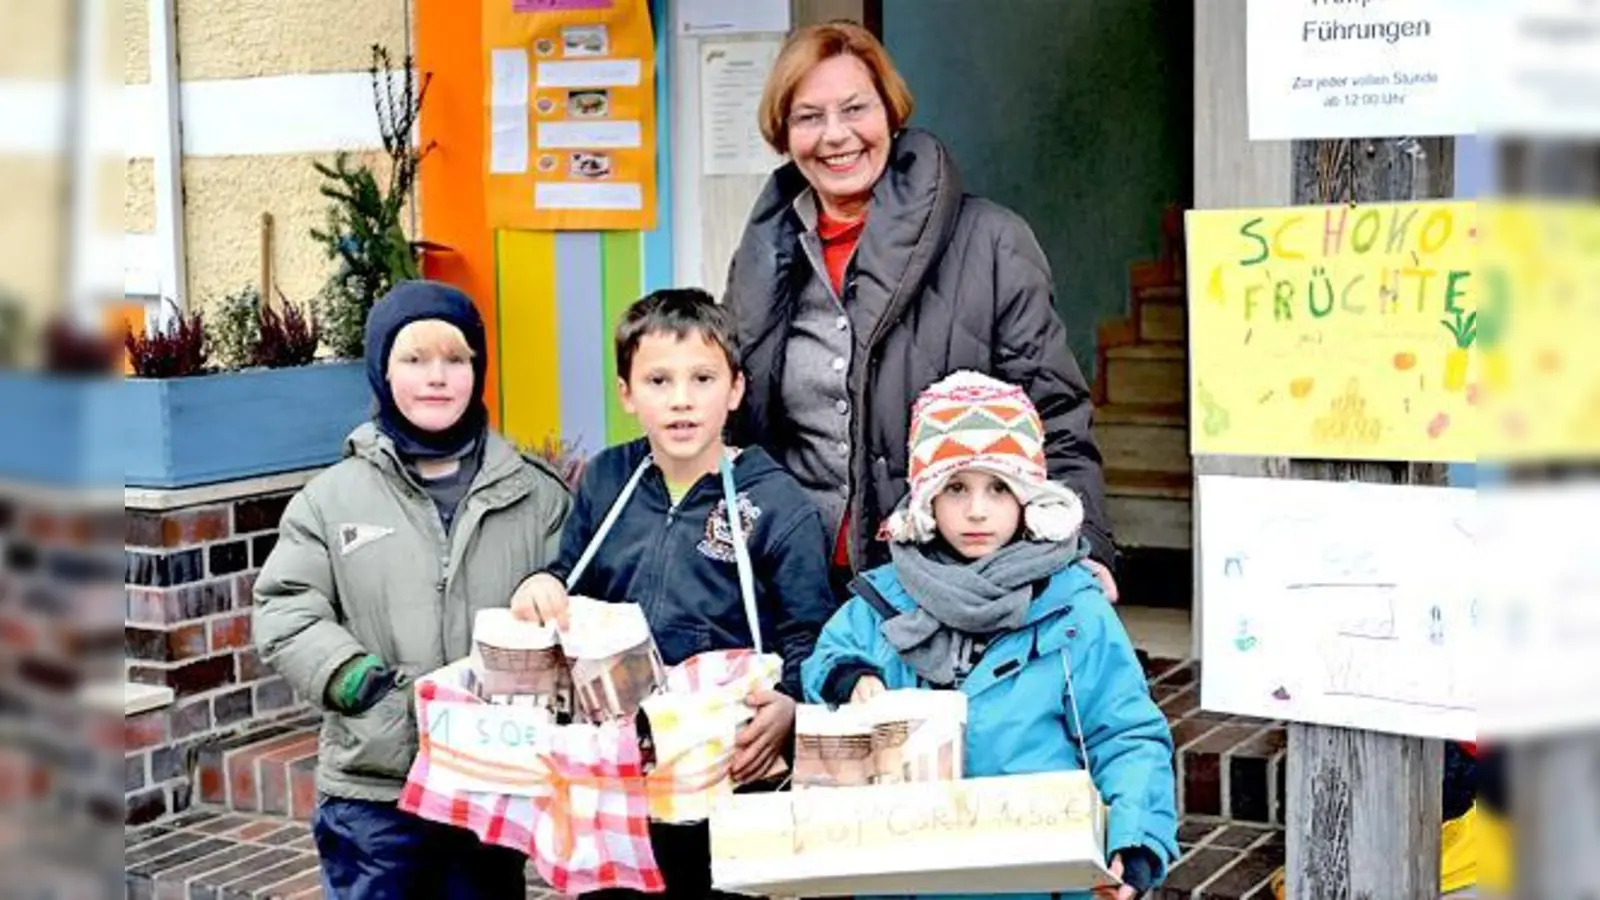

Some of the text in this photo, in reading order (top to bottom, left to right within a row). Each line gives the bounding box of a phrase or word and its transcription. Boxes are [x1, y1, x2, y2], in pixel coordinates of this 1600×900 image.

[1302, 19, 1432, 45] Führungen
[1292, 76, 1313, 90] Zur
[1316, 75, 1348, 91] jeder
[1393, 70, 1438, 85] Stunde
[1381, 91, 1405, 104] Uhr
[1238, 206, 1453, 266] SCHOKO
[1243, 265, 1472, 322] FRÜCHTE
